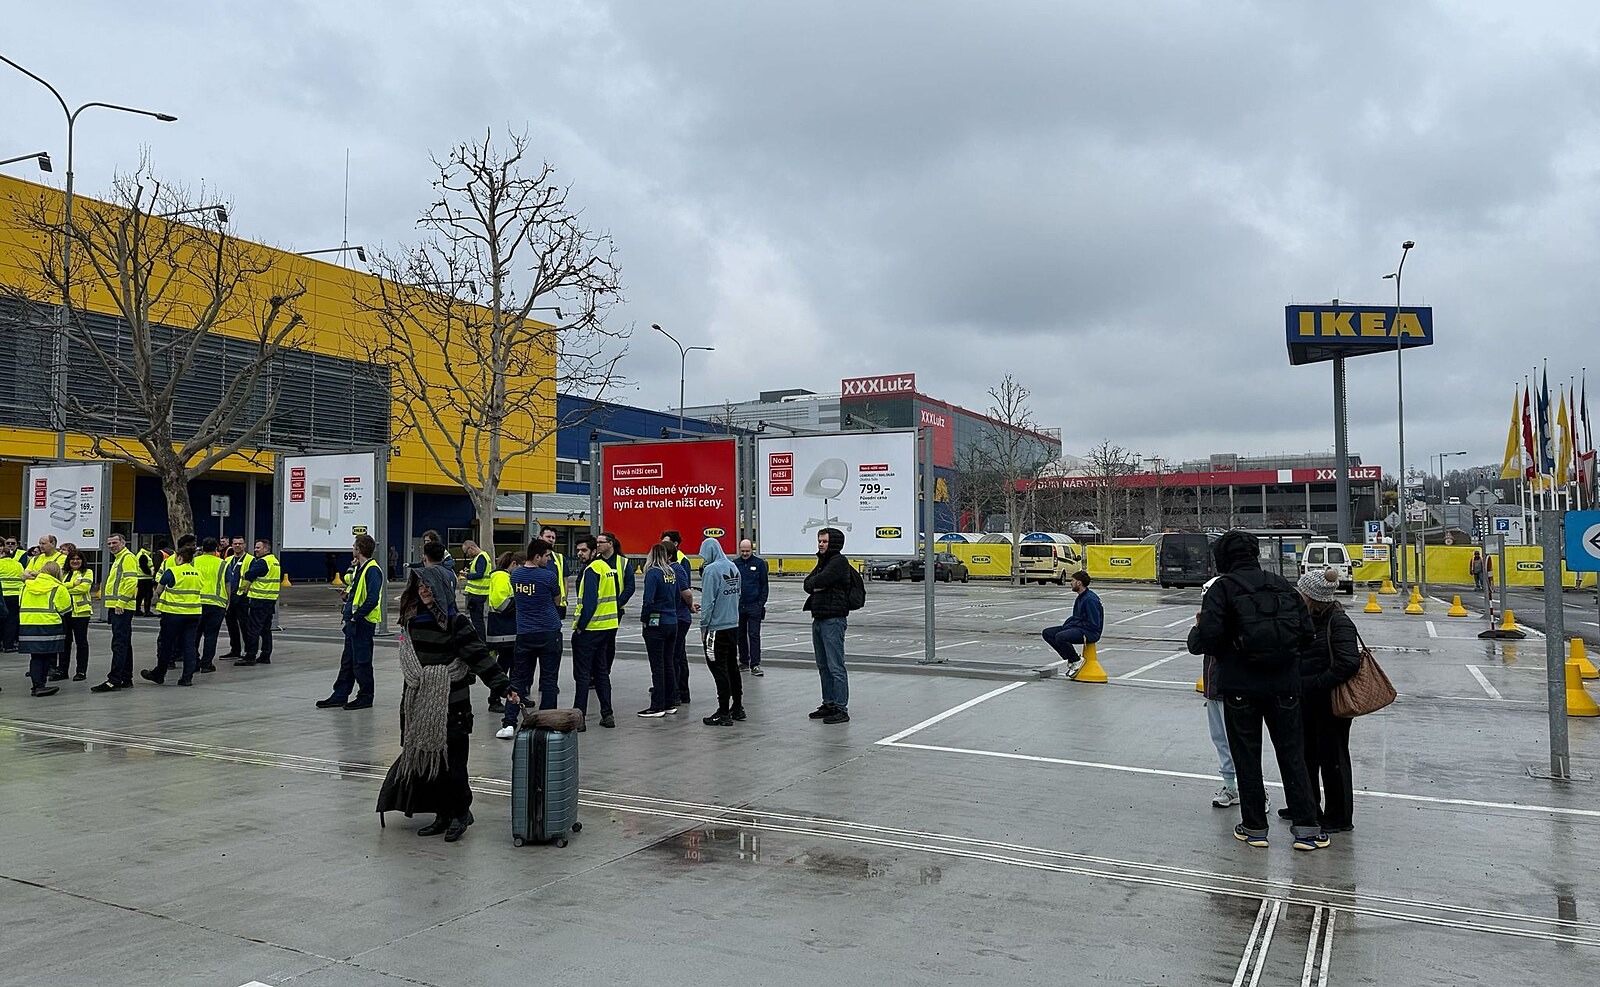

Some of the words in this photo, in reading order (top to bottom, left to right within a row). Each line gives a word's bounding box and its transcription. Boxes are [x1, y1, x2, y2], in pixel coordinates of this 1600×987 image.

[1299, 311, 1426, 338] IKEA
[843, 377, 913, 395] XXXLutz
[920, 410, 945, 428] XXXLutz
[616, 468, 631, 476] Nová
[772, 470, 787, 478] nižší
[1316, 468, 1377, 480] XXLutz
[613, 486, 635, 496] Naše
[637, 485, 676, 495] oblíbené
[678, 484, 717, 496] výrobky
[613, 499, 633, 511] nyní
[646, 498, 673, 508] trvale
[675, 497, 697, 508] nižší
[699, 499, 724, 509] ceny.
[515, 583, 536, 596] Hej!
